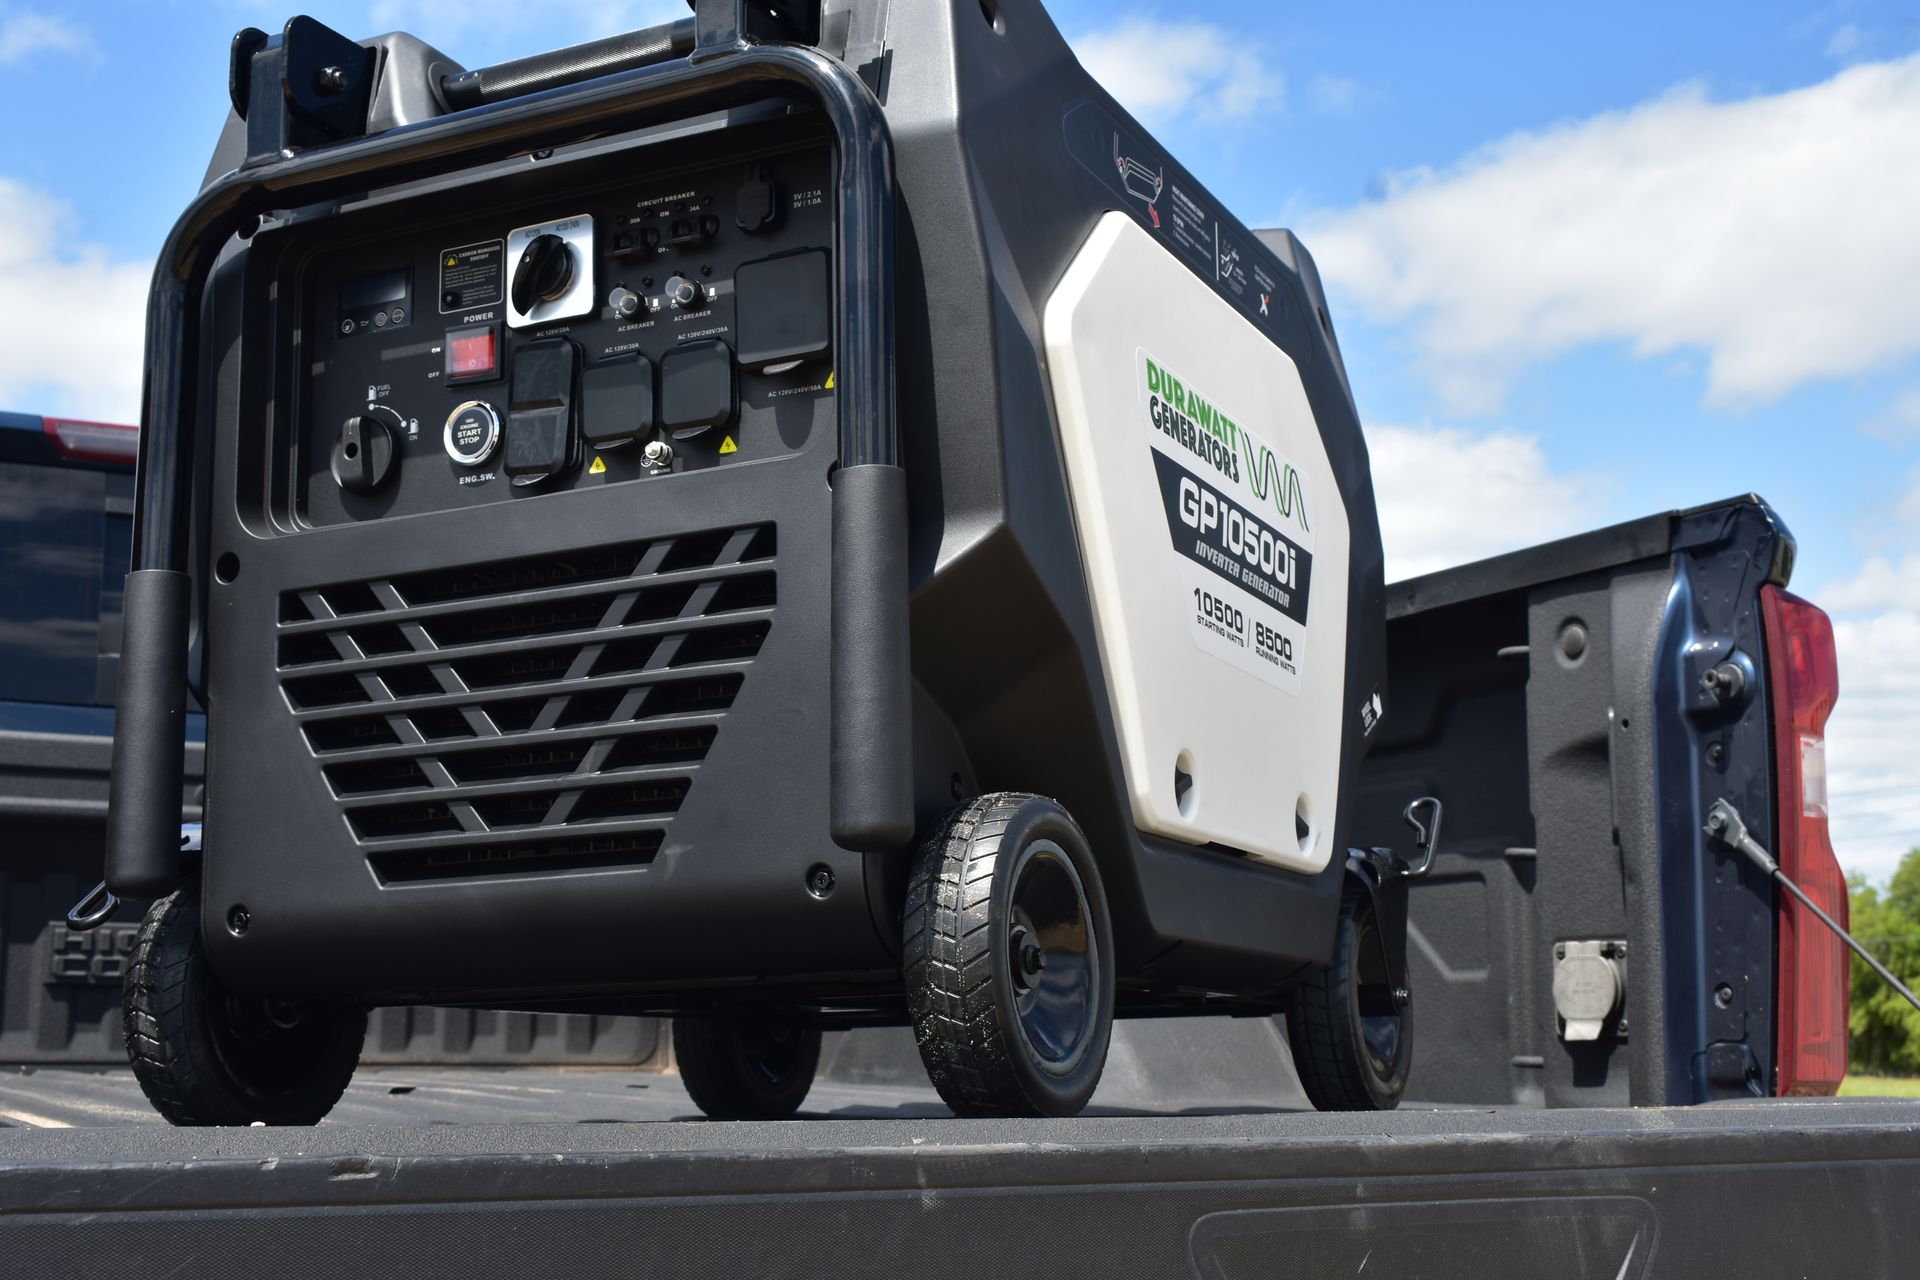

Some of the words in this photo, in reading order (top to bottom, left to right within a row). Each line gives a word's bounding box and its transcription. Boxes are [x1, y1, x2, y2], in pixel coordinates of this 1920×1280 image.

[637, 198, 664, 207] CIRCUIT
[665, 191, 695, 201] BREAKER
[463, 312, 494, 324] POWER
[627, 321, 655, 330] BREAKER
[683, 310, 711, 320] BREAKER
[687, 326, 728, 338] 120V/240V/30A
[614, 343, 639, 352] 120V/30A
[1146, 358, 1236, 452] DURAWATT
[458, 428, 482, 438] START
[460, 436, 480, 445] STOP
[1150, 395, 1240, 484] GENERATORS
[1179, 476, 1296, 590] GP10500i
[1195, 540, 1240, 578] INVERTER
[1242, 568, 1290, 608] GENERATOR
[1194, 588, 1244, 634] 10500
[1197, 614, 1226, 638] STARTING
[1226, 630, 1244, 648] WATTS
[1256, 621, 1292, 662] 8500
[1256, 646, 1279, 667] RUNNING
[1280, 658, 1296, 675] WATTS
